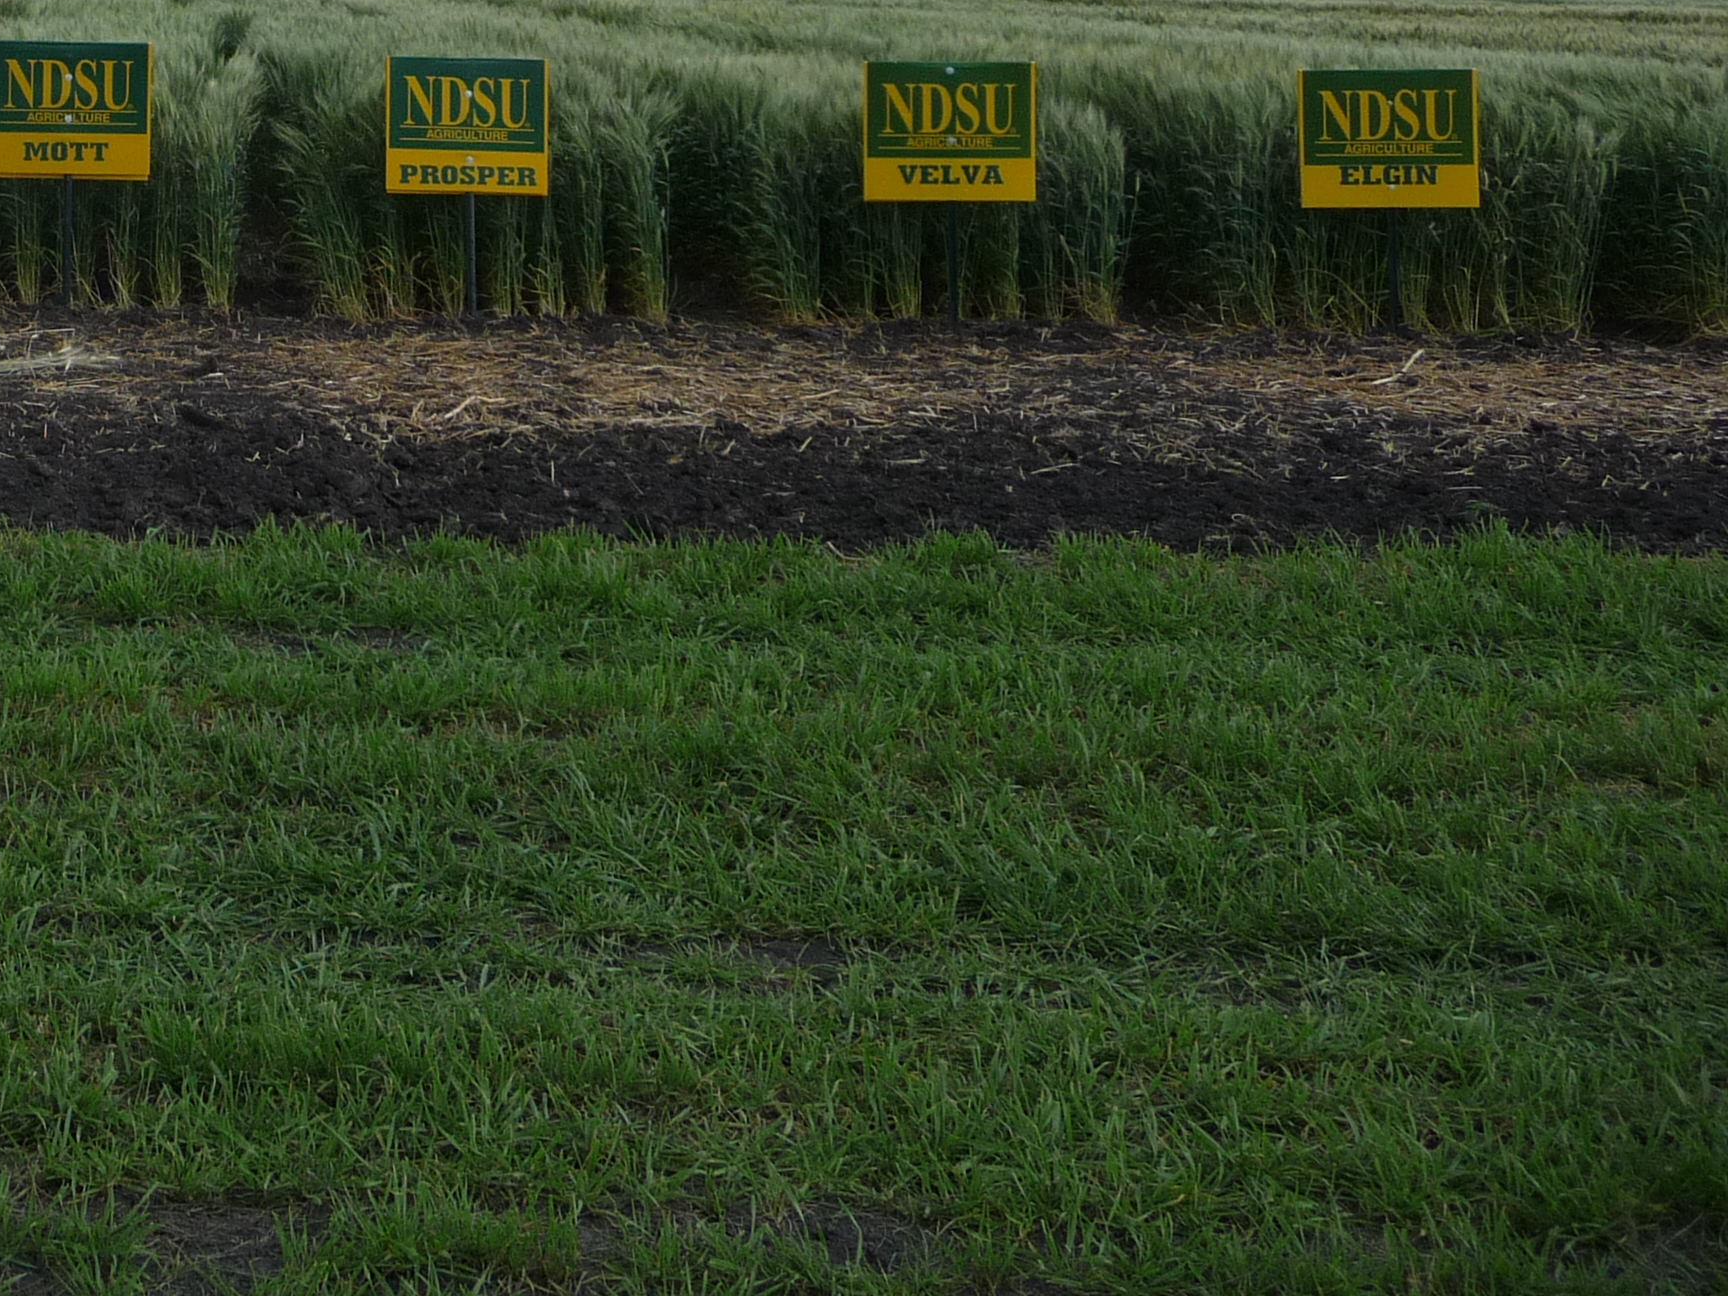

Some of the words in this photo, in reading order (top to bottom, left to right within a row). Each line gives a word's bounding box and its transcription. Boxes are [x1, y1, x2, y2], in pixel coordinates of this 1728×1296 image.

[3, 58, 133, 110] NDSU
[403, 75, 530, 127] NDSU
[882, 83, 1016, 134] NDSU
[26, 112, 111, 123] AGRICLTURE
[1317, 89, 1455, 140] NDSU
[426, 129, 508, 140] AGRICULTURE
[23, 142, 109, 162] MOTT
[1344, 143, 1433, 153] AGRICULTURE
[399, 165, 537, 186] PROSPER
[898, 164, 1004, 185] VELVA
[1339, 165, 1437, 185] ELGIN
